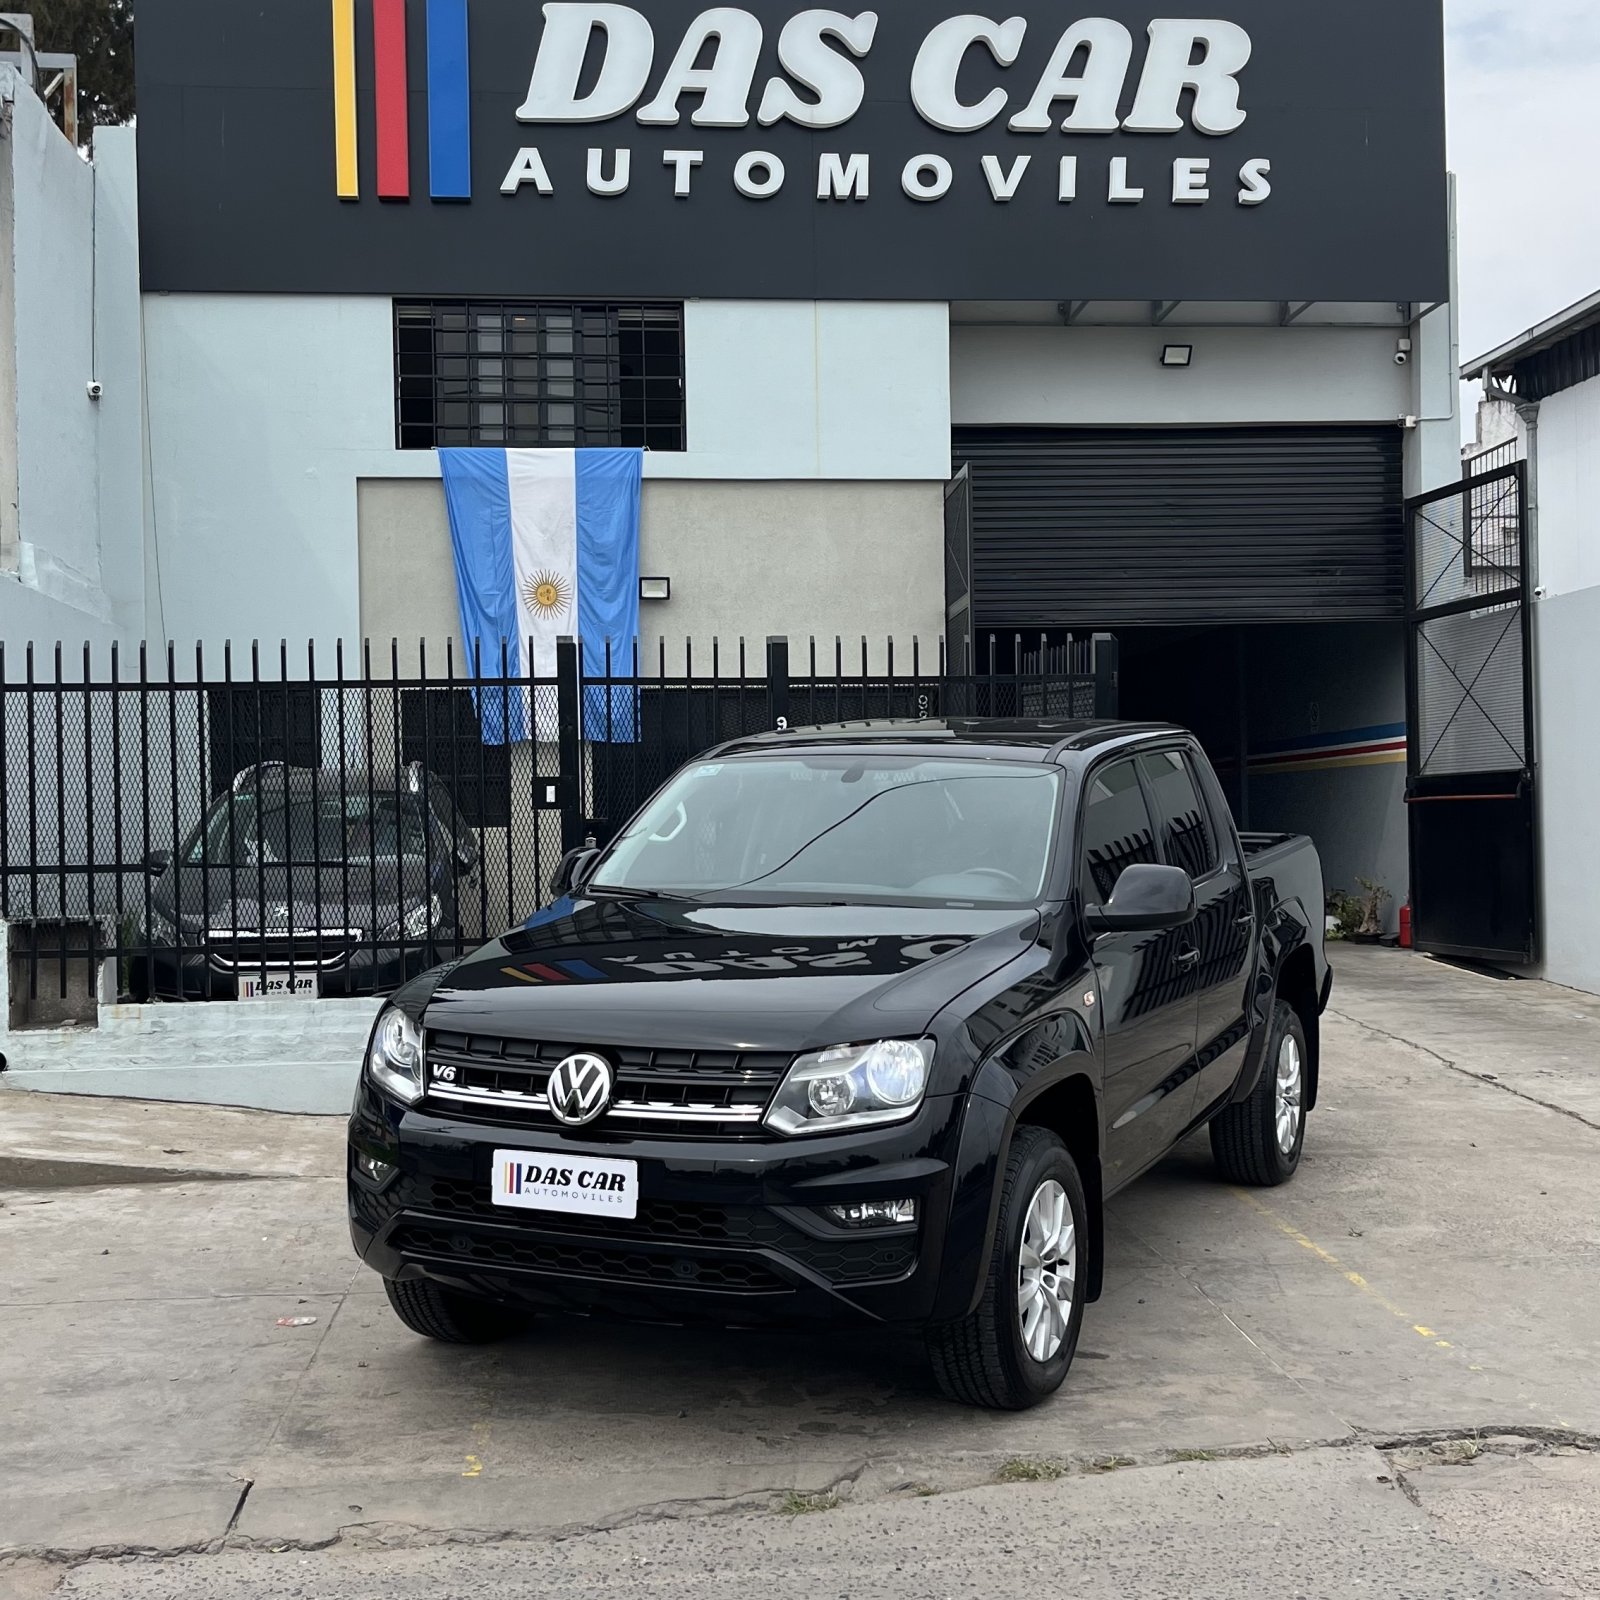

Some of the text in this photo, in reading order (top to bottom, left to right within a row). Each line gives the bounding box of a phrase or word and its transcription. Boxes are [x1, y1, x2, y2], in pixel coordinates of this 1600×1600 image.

[516, 3, 1252, 136] DAS CAR
[500, 147, 1271, 205] AUTOMOVILES
[433, 1063, 457, 1081] V6
[524, 1165, 626, 1192] DAS CAR
[524, 1187, 623, 1203] AUTOMOVILES
